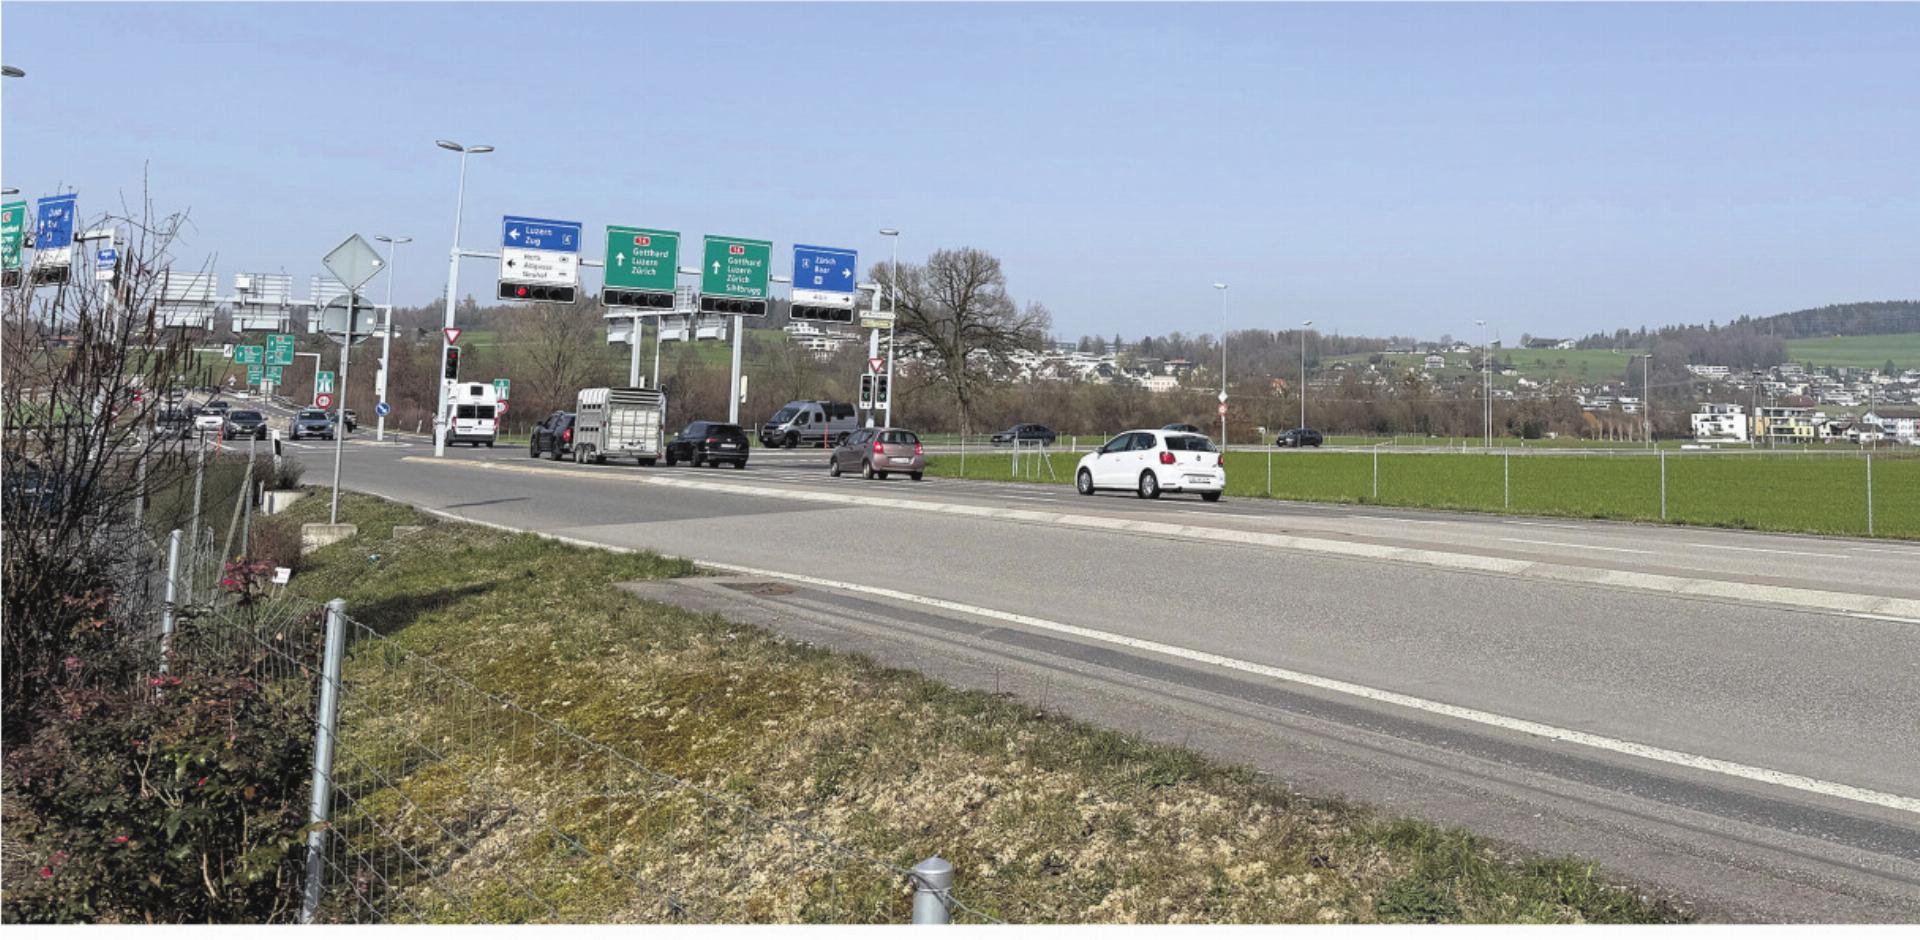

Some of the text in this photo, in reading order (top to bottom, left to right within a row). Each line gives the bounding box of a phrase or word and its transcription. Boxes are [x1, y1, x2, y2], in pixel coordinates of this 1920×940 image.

[525, 226, 552, 236] Luzern
[525, 236, 541, 247] Zug
[633, 247, 669, 258] Gotthard
[631, 257, 658, 266] Luzern
[727, 256, 762, 267] Gotthard
[815, 256, 837, 265] Zürich
[631, 266, 656, 276] Zürich
[727, 266, 752, 274] Luzern
[814, 265, 830, 274] Baar
[726, 274, 750, 283] Zürich
[726, 284, 762, 296] Sihlbrugg
